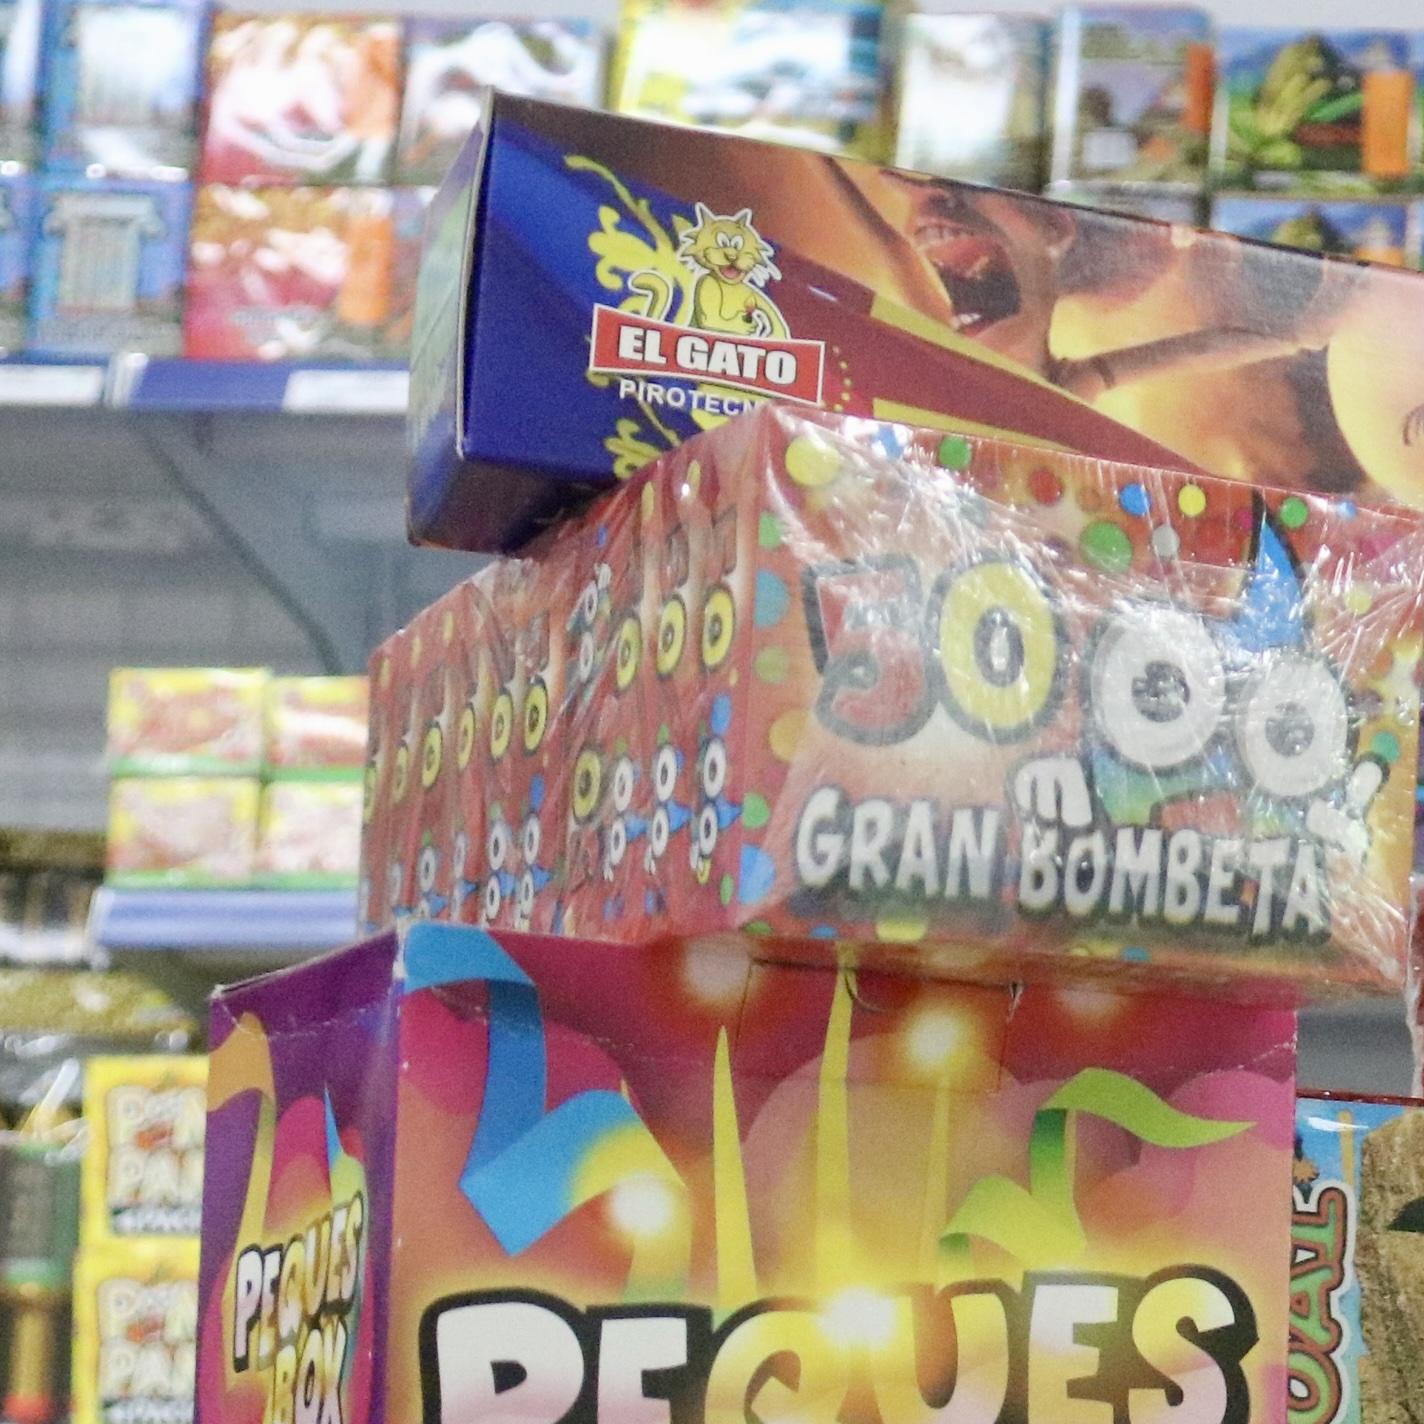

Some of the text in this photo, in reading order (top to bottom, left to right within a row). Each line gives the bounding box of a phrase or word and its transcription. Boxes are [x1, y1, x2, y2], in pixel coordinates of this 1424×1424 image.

[618, 325, 797, 386] EL GATO
[618, 379, 760, 416] PIROTECN
[795, 785, 1332, 943] GRAN BOMBETA
[234, 1190, 364, 1373] PEQUES
